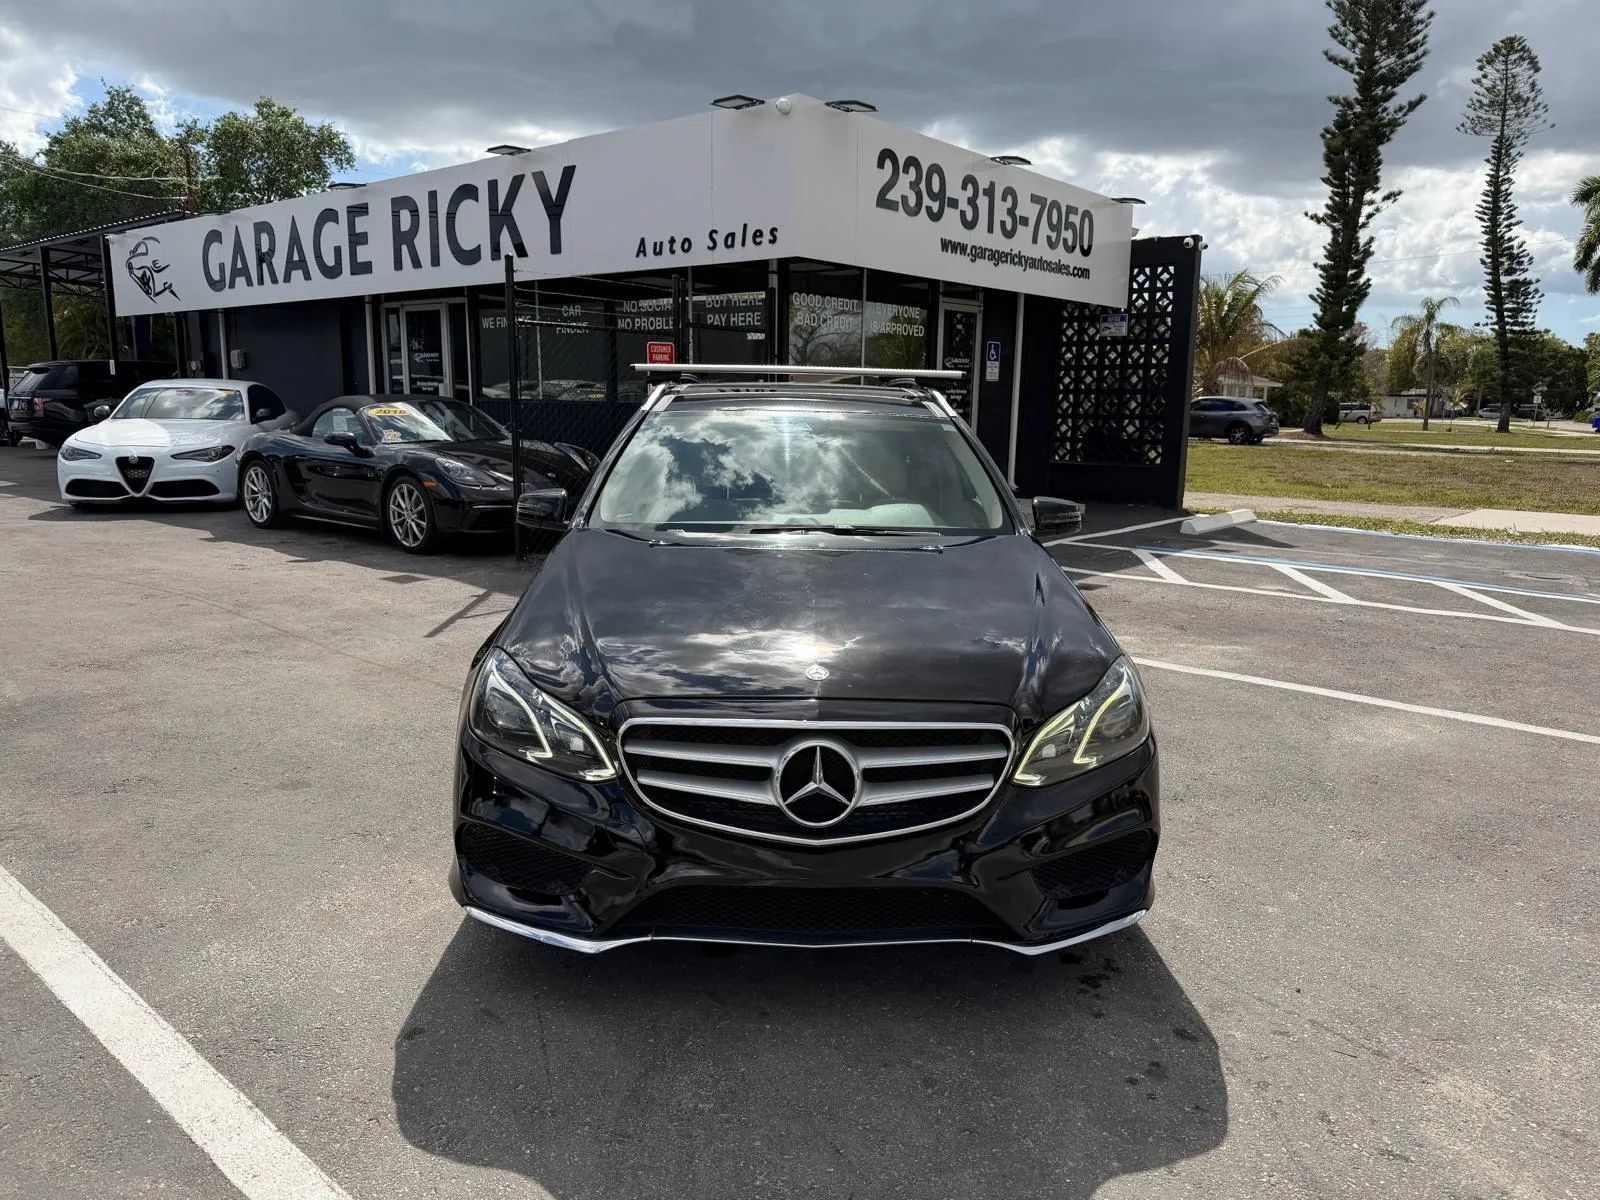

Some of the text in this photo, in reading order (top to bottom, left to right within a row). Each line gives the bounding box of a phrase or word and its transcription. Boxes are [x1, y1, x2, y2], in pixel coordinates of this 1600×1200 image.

[875, 147, 1094, 258] 239-313-7950
[201, 165, 577, 293] GARAGE RICKY
[635, 223, 779, 259] Auto Sales
[940, 237, 1091, 281] www.garagerickyautosales.com
[623, 299, 673, 313] NO SOCIA
[706, 293, 763, 308] BUY HERE
[792, 291, 858, 311] GOOD CREDIT
[561, 304, 582, 317] CAR
[876, 304, 921, 319] EVERYONE
[481, 317, 495, 329] WE
[617, 317, 676, 331] NO PROBLE
[706, 312, 762, 326] PAY HERE
[795, 312, 853, 330] BAD CREDIT
[869, 320, 925, 337] IS APPROVED
[652, 353, 671, 362] PARKING
